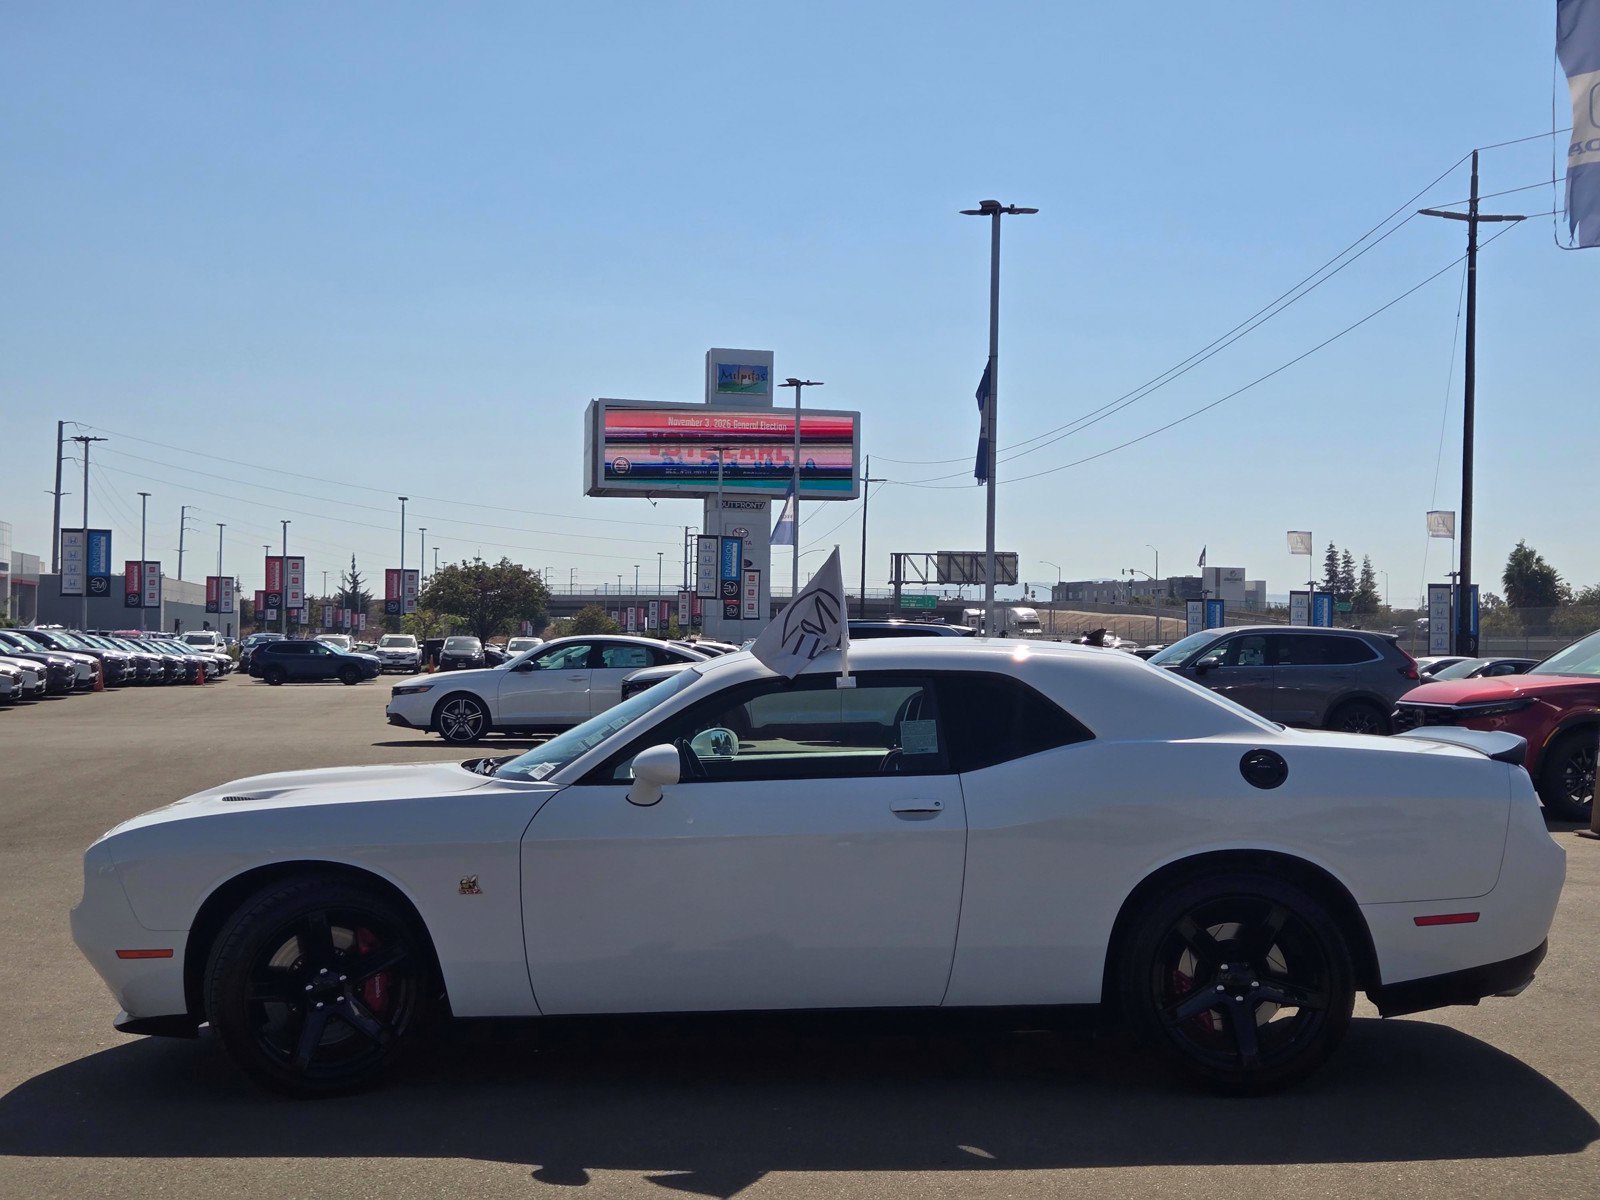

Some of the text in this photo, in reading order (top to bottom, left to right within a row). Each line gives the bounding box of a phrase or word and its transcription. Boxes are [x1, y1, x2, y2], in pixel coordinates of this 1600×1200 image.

[720, 365, 767, 385] Milpitas
[668, 417, 702, 427] November
[734, 420, 759, 430] General
[760, 421, 787, 431] Election
[724, 541, 732, 577] ENVISION
